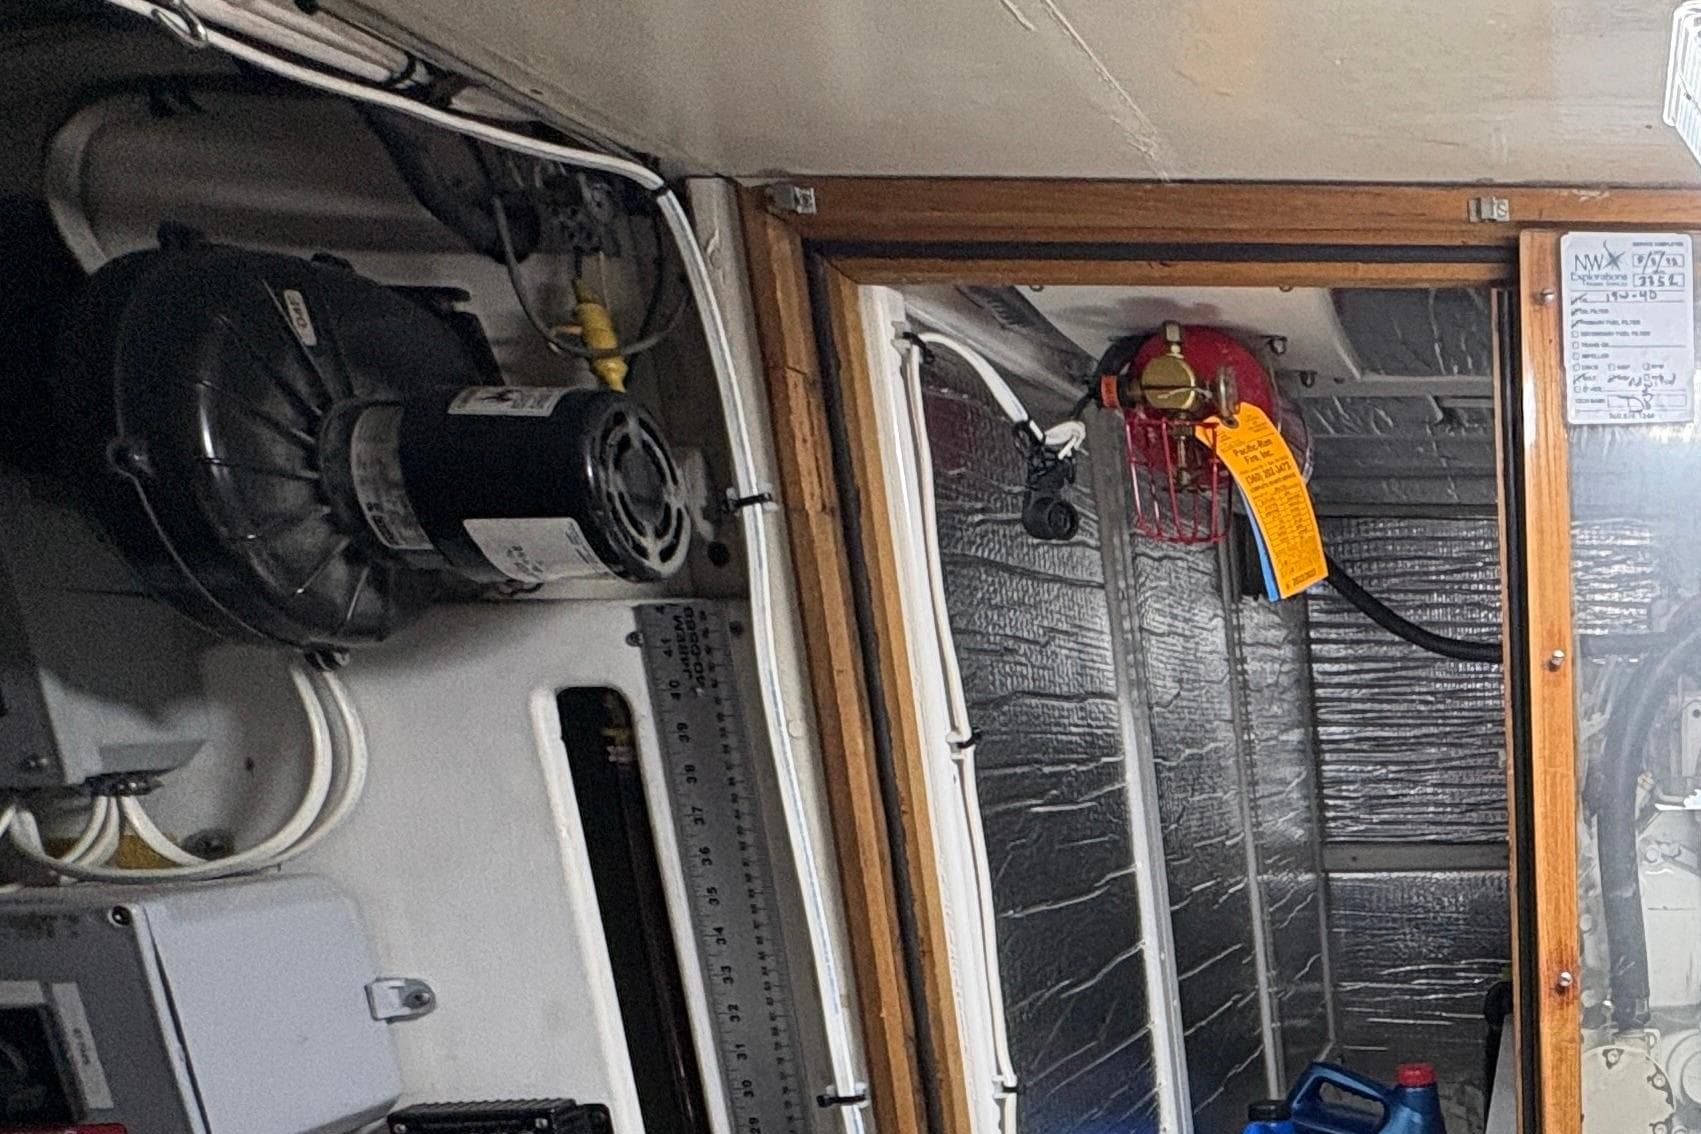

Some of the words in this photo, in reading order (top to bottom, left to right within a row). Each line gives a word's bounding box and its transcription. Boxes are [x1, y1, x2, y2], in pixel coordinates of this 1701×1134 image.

[676, 722, 690, 743] 39
[684, 764, 698, 784] 38
[691, 806, 706, 825] 37
[699, 847, 713, 866] 36
[706, 886, 720, 906] 35
[713, 926, 728, 945] 34
[720, 965, 735, 985] 33
[728, 1004, 741, 1023] 32
[735, 1043, 748, 1060] 31
[742, 1080, 755, 1098] 30
[749, 1117, 762, 1134] 29
